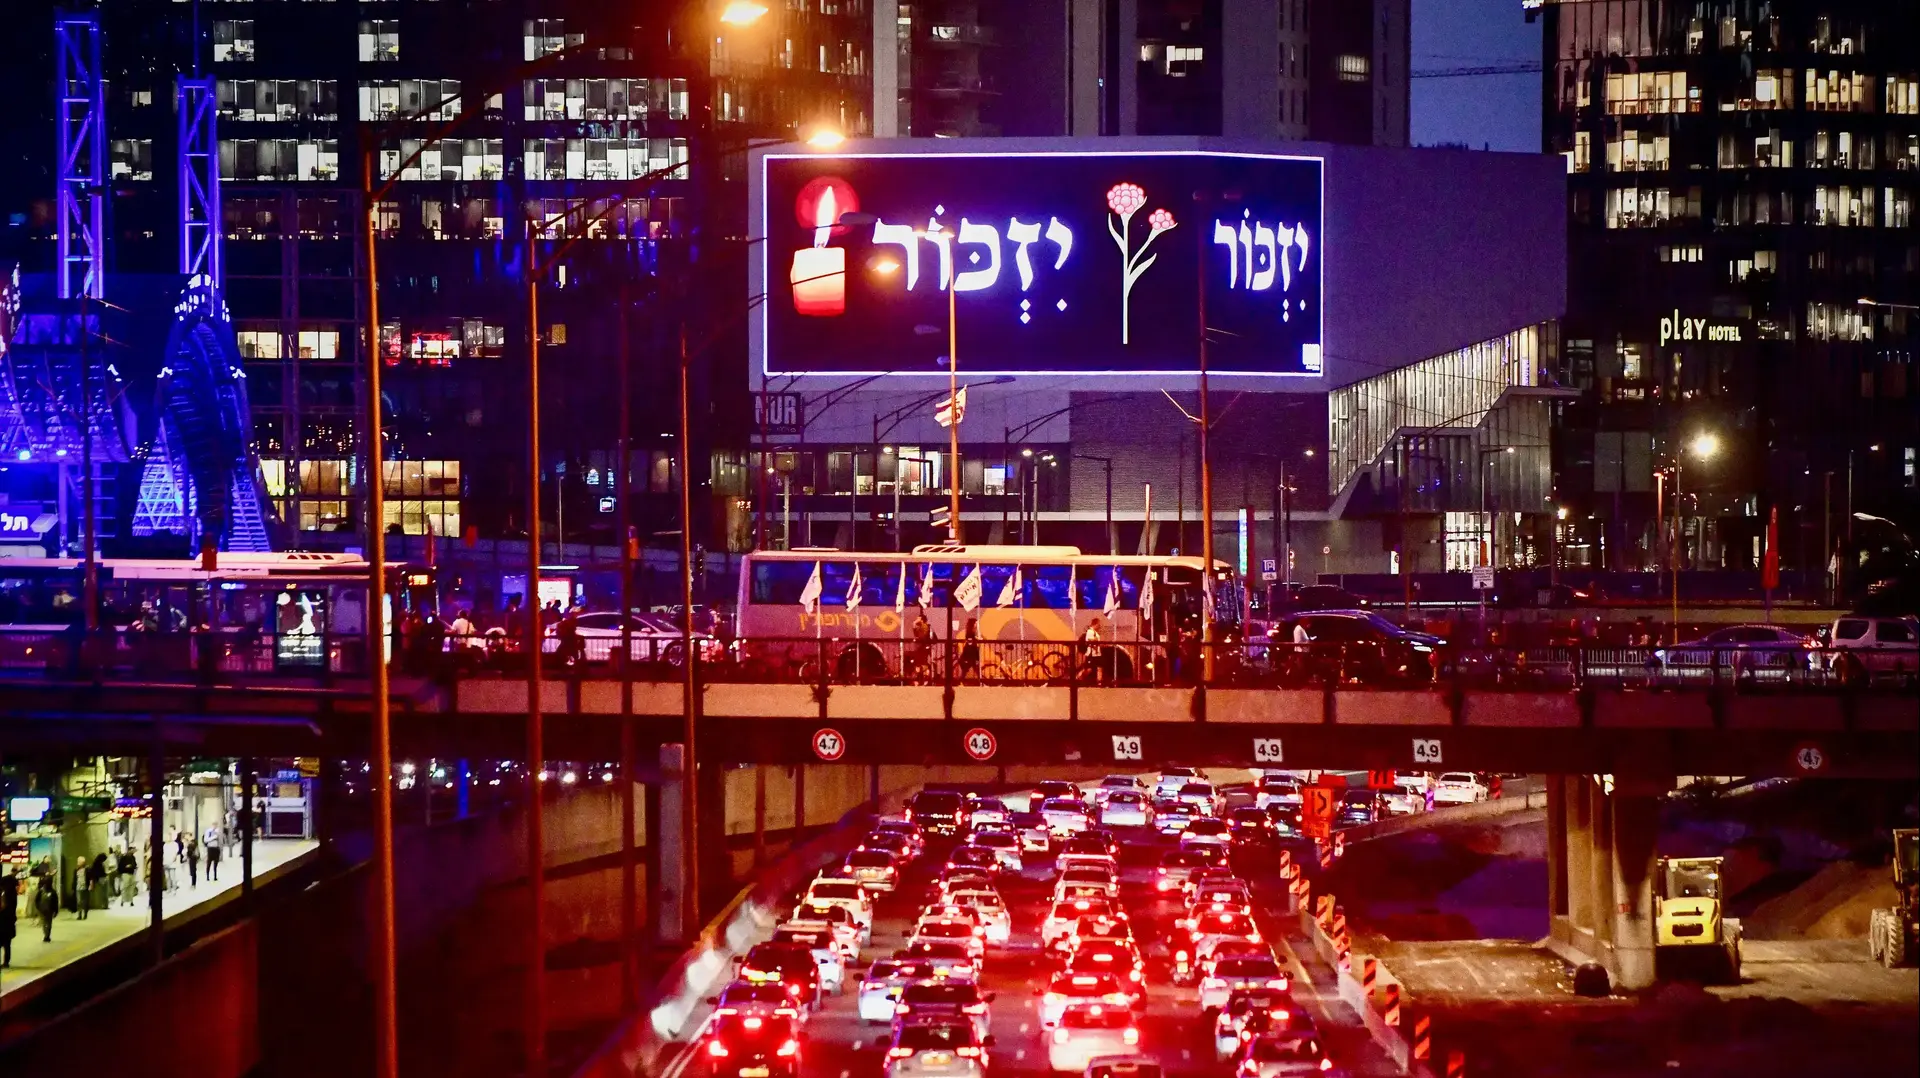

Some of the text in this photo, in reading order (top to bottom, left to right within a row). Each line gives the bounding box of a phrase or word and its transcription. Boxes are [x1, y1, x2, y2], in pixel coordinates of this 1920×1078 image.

[1708, 325, 1742, 341] HOTEL
[818, 737, 838, 751] 4.7
[970, 737, 990, 751] 4.8
[1116, 741, 1139, 755] 4.9
[1257, 743, 1280, 757] 4.9
[1416, 744, 1439, 758] 4.9
